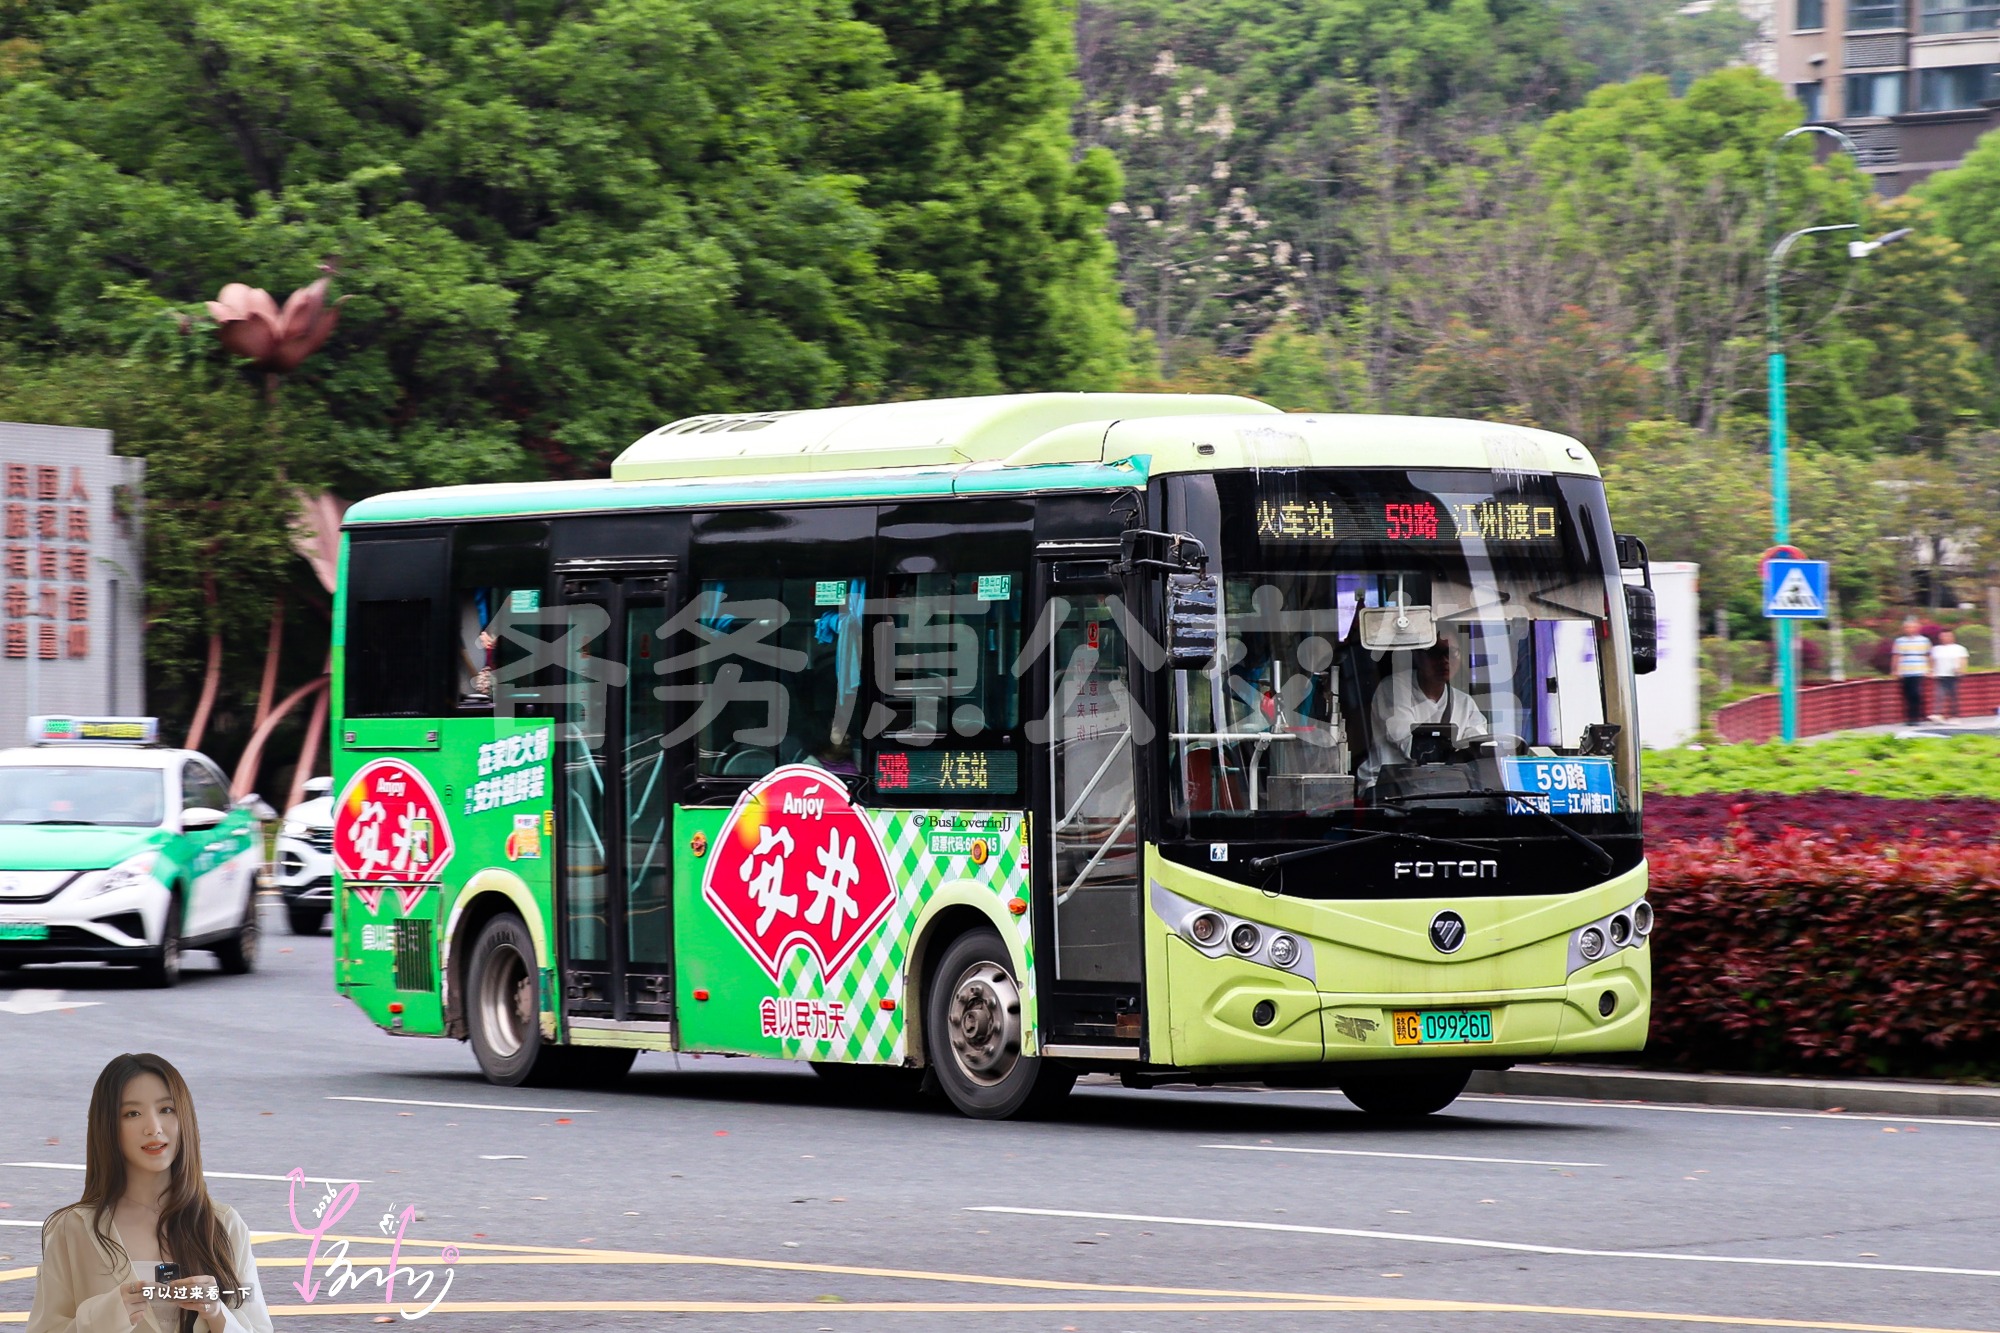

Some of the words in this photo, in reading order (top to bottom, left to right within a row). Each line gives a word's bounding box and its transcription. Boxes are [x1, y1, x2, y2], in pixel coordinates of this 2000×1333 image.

[1257, 500, 1334, 538] 火车站
[1385, 501, 1439, 539] 59路
[1452, 501, 1556, 540] 江州渡口
[939, 751, 989, 789] 火车站
[1535, 763, 1588, 791] 59路
[783, 787, 825, 821] Anjoy
[1567, 792, 1613, 814] 江州渡口
[739, 825, 860, 942] 安井
[1394, 860, 1498, 879] FOTON
[761, 998, 846, 1040] 食以民为天
